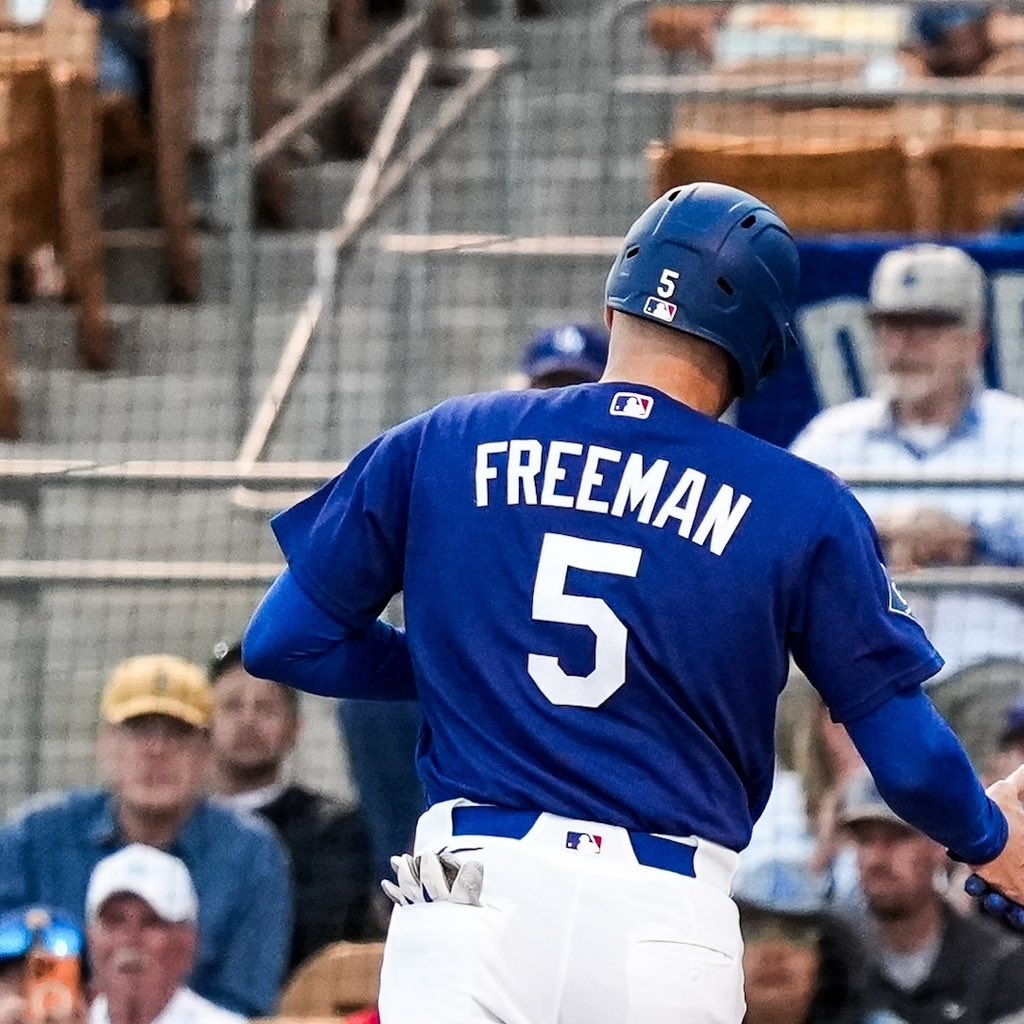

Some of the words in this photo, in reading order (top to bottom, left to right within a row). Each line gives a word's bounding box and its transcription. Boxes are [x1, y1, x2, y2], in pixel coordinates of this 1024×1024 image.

[657, 268, 680, 299] 5
[475, 439, 752, 556] FREEMAN
[527, 532, 643, 708] 5
